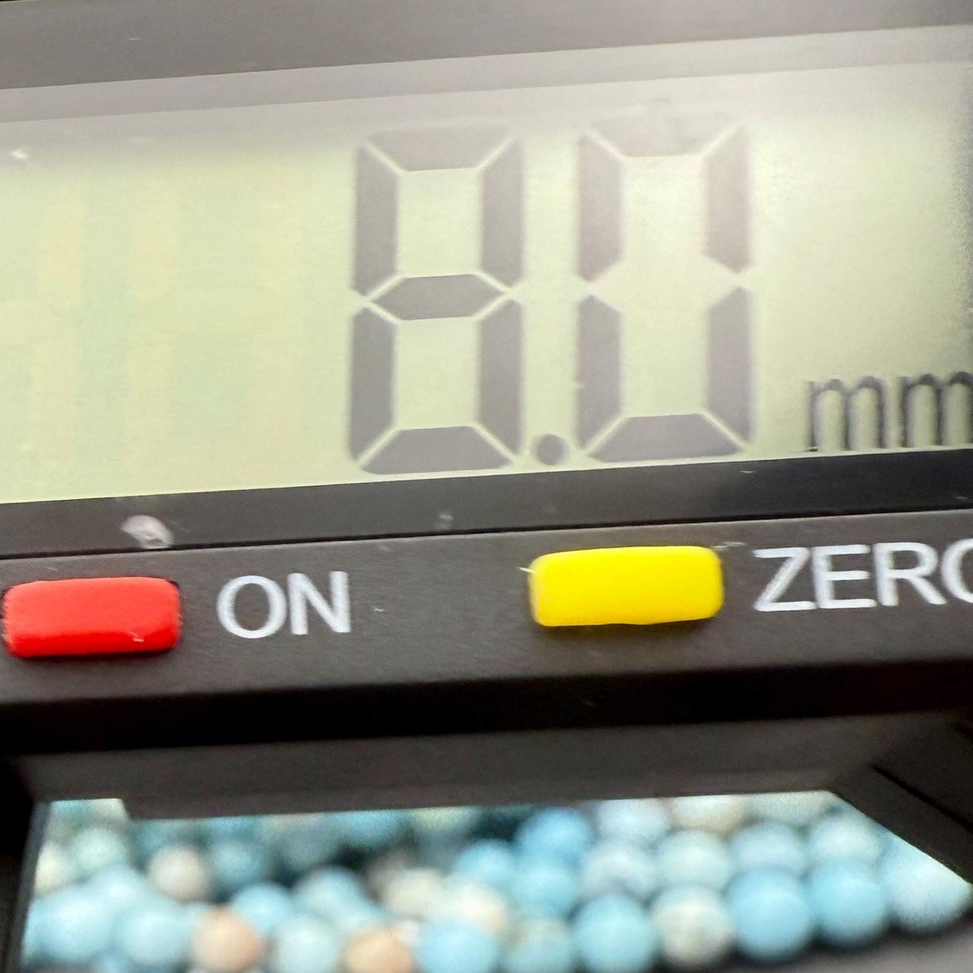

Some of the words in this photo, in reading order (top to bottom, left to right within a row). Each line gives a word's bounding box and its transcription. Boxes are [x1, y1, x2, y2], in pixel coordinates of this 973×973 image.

[348, 114, 753, 476] 8.0
[806, 370, 973, 453] mm
[216, 570, 352, 639] ON
